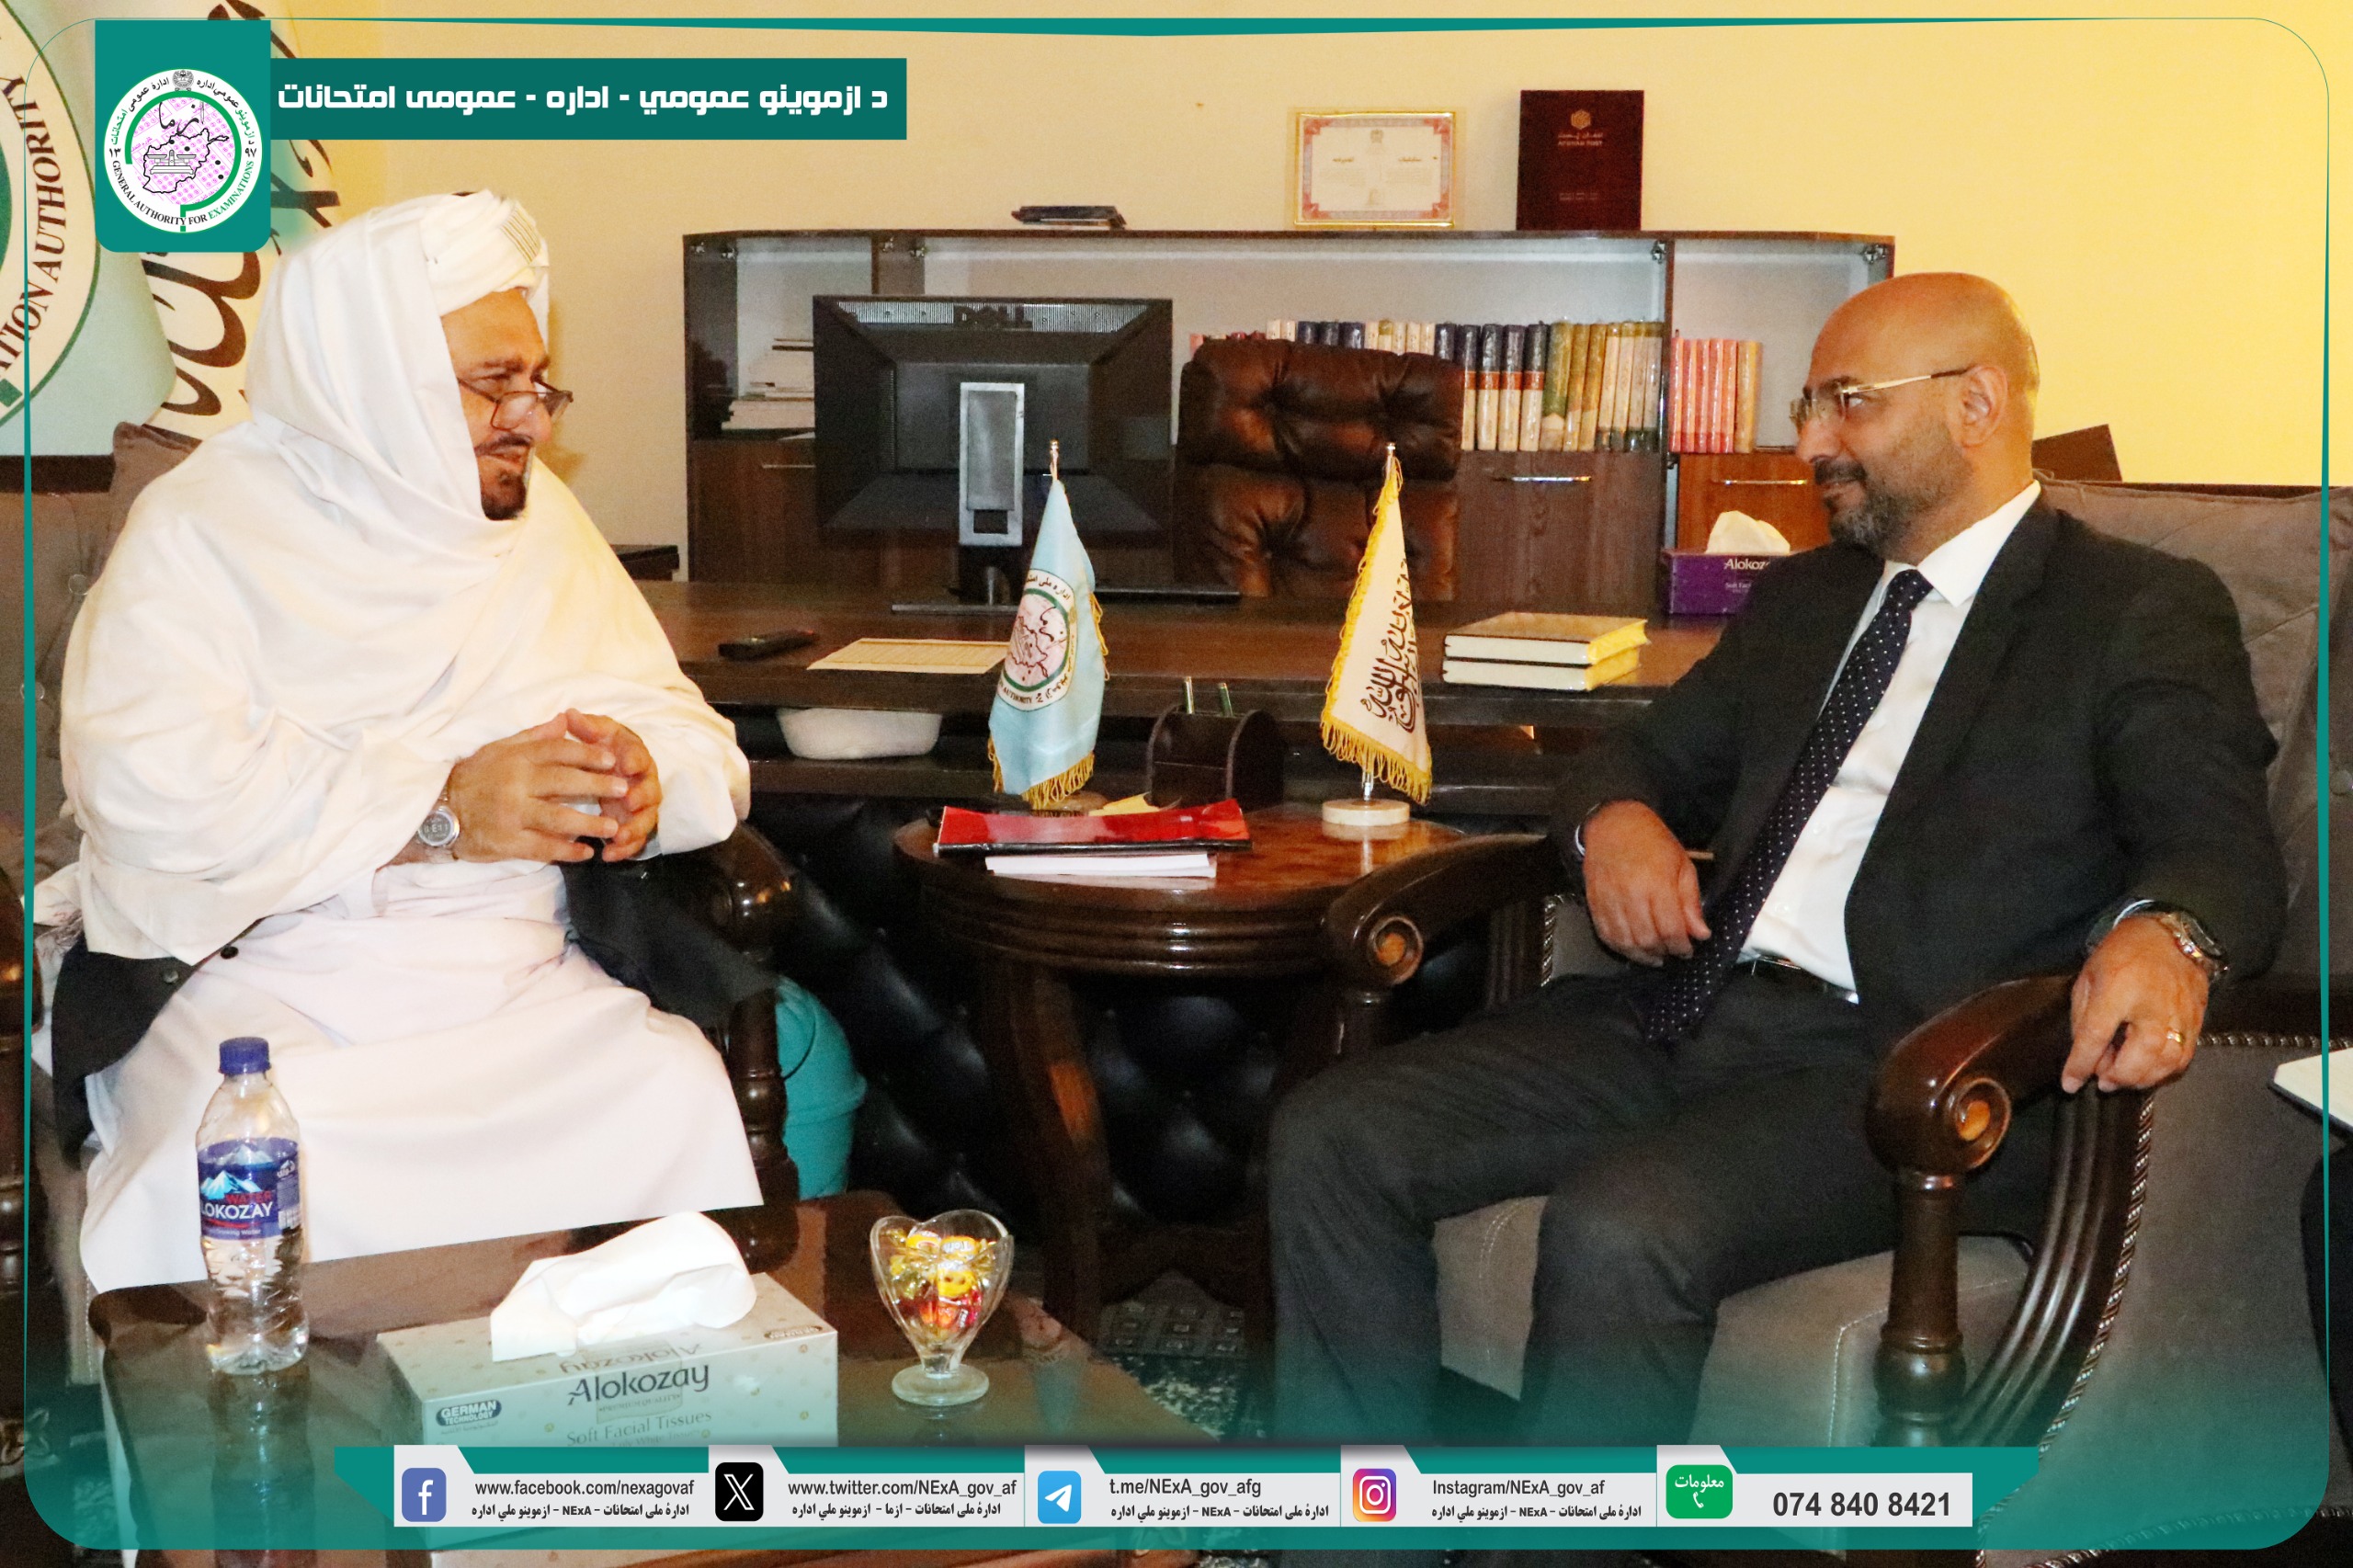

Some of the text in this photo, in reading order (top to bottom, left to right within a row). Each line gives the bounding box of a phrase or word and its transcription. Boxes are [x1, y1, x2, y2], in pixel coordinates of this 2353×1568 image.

[0, 75, 67, 284] AUTHORITY
[1723, 557, 1771, 570] Alokoz
[567, 1364, 710, 1406] Alokozay
[441, 1400, 497, 1418] GERMAN
[445, 1410, 494, 1426] TECHNOLOGY
[567, 1411, 711, 1447] Soft Facial Tissues
